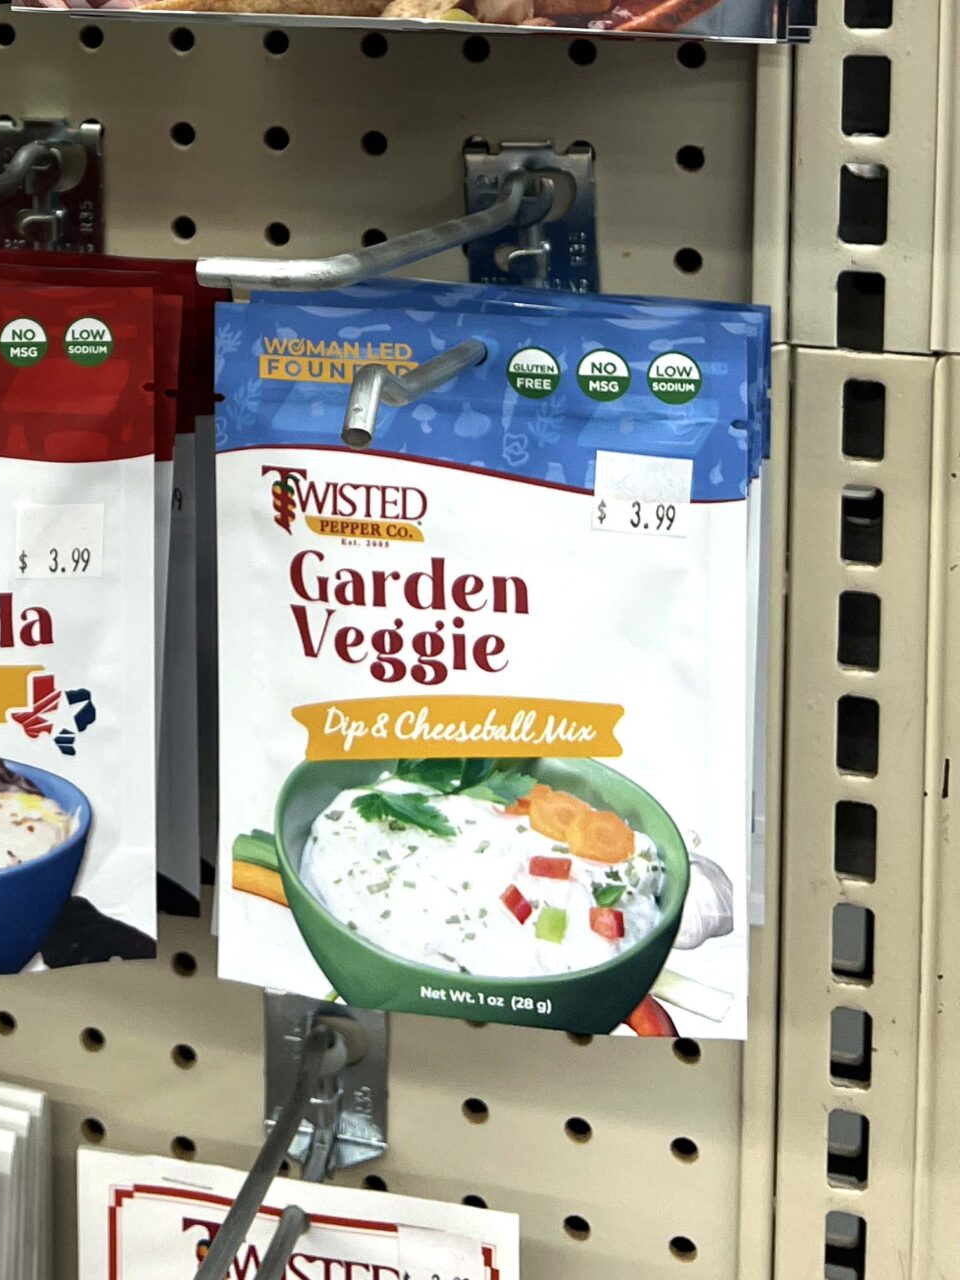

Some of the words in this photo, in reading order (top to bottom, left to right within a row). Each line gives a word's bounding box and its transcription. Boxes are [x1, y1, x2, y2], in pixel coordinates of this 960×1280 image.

[12, 329, 35, 341] NO
[72, 329, 106, 340] LOW
[10, 347, 38, 357] MSG
[68, 346, 107, 354] SODIUM
[264, 336, 359, 358] WOMAN
[367, 342, 412, 360] LED
[513, 363, 554, 373] GLUTEN
[592, 362, 617, 375] NO
[656, 365, 693, 377] LOW
[517, 378, 551, 390] FREE
[589, 381, 619, 392] MSG
[652, 382, 695, 392] SODIUM
[261, 465, 427, 536] TWISTED
[597, 500, 607, 524] $
[630, 501, 676, 531] 3.99
[320, 520, 381, 536] PEPPER
[18, 552, 28, 574] $
[49, 547, 91, 573] 3.99
[289, 550, 529, 615] Garden
[290, 604, 509, 686] Veggie
[324, 706, 367, 752] Dip
[371, 714, 389, 735] &
[394, 709, 534, 742] Cheeseball
[533, 715, 596, 744] Mix
[420, 986, 446, 1000] Net
[450, 989, 475, 1004] Wt.
[478, 992, 484, 1004] 1
[488, 997, 504, 1007] oz
[511, 996, 533, 1010] (28
[537, 999, 552, 1014] g)
